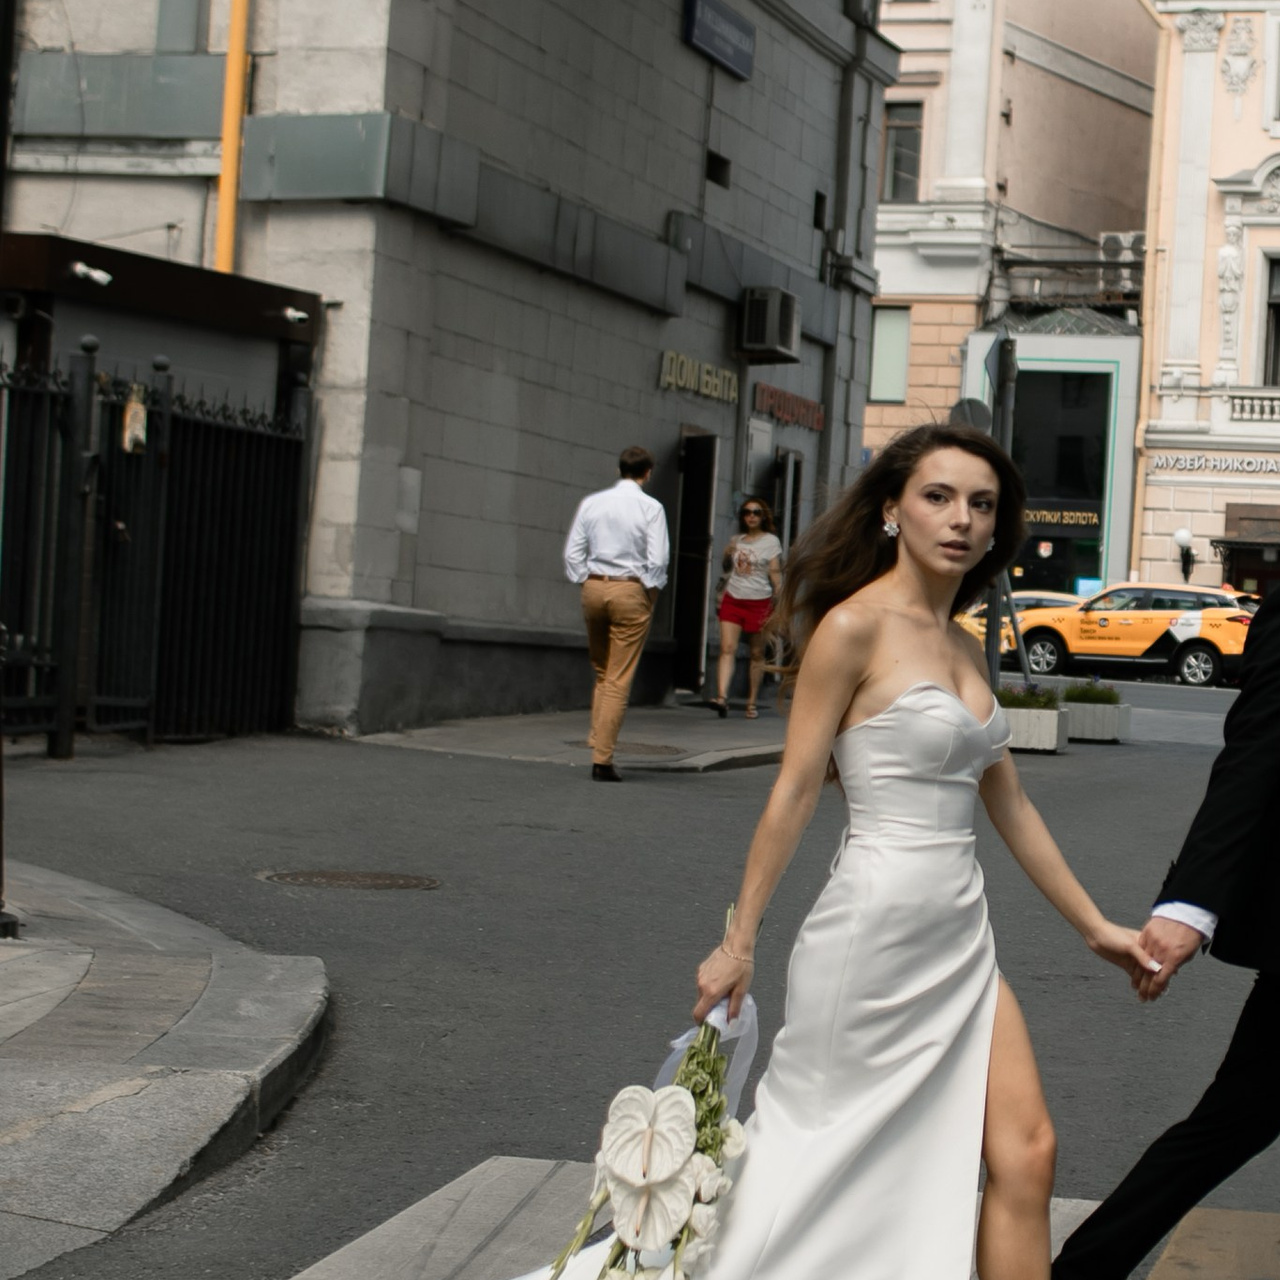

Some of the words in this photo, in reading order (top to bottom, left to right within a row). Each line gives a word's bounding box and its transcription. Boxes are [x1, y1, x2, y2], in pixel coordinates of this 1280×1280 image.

[660, 350, 699, 391] ДОМ
[702, 363, 739, 405] БЫТА
[754, 380, 826, 432] ПРОДУКТЫ
[1154, 454, 1206, 471] МУЗЕЙ
[1062, 510, 1099, 525] ЗОЛОТА
